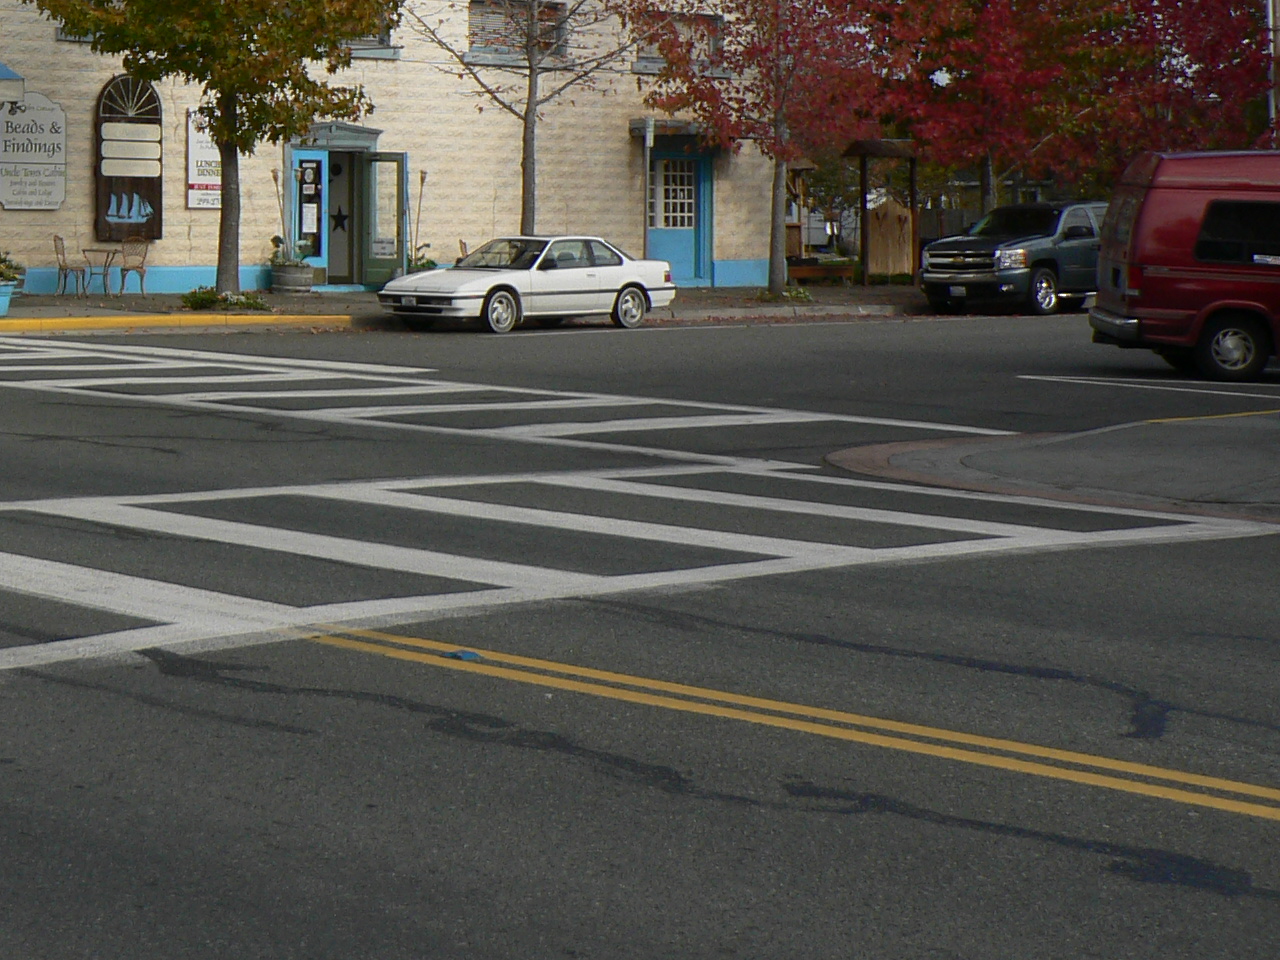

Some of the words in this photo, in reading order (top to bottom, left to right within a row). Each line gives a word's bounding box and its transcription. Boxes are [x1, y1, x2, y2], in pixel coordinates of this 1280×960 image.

[5, 119, 45, 134] Beads
[49, 121, 62, 134] &
[2, 137, 62, 158] Findings
